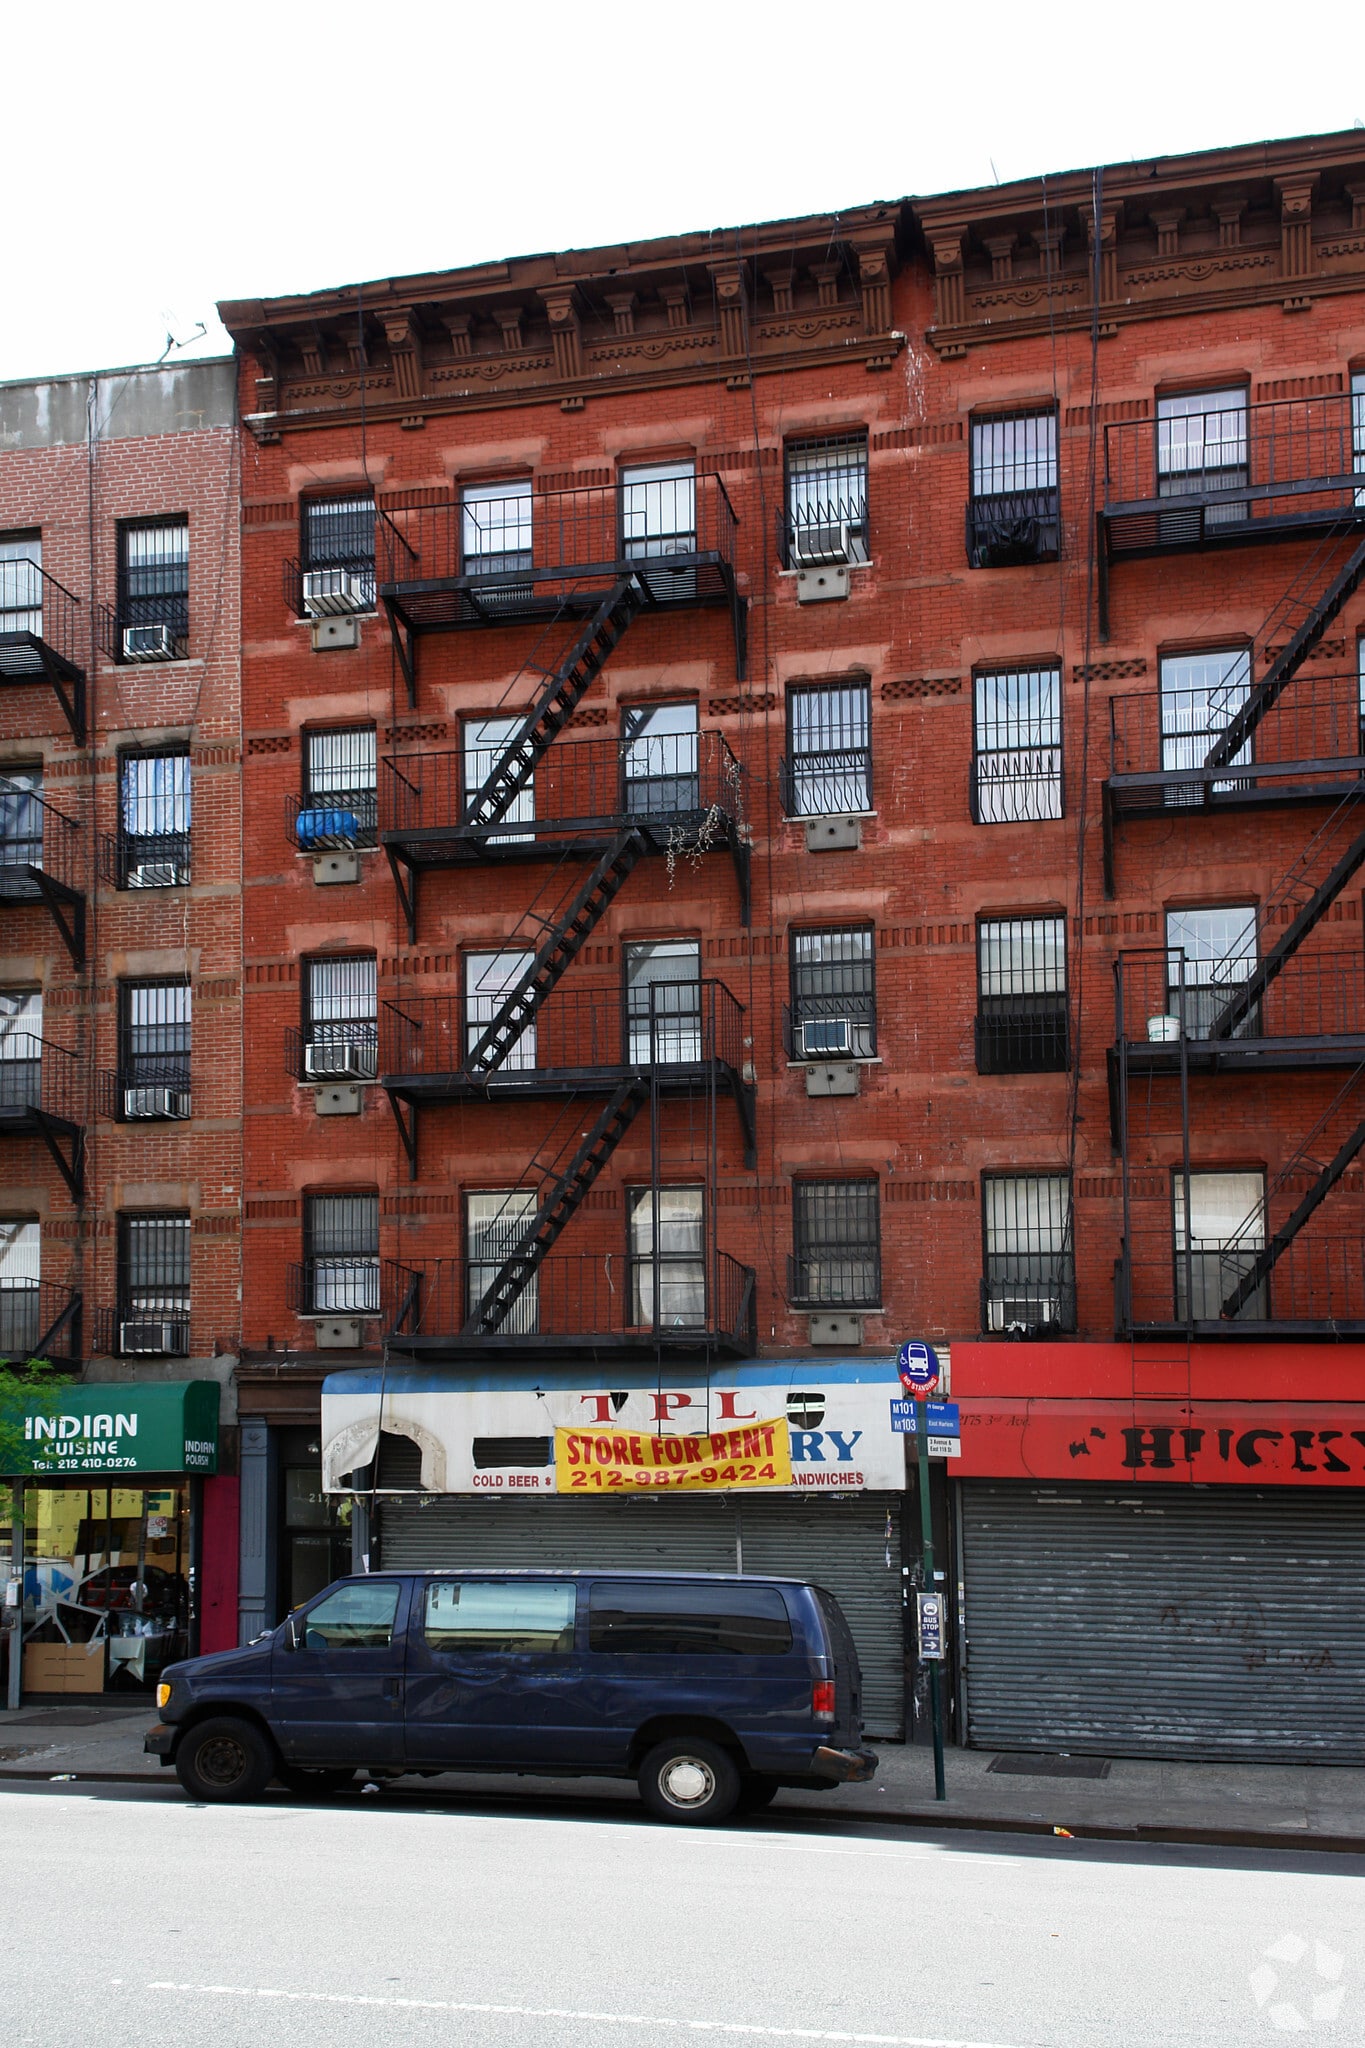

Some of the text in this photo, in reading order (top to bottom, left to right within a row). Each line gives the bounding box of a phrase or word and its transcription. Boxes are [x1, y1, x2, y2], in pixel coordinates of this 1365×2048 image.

[903, 1376, 937, 1391] NO STANDING
[892, 1402, 914, 1415] M101
[24, 1413, 138, 1440] INDIAN
[894, 1419, 916, 1431] M103
[43, 1441, 118, 1456] CUISINE
[184, 1440, 215, 1454] INDIAN
[567, 1426, 775, 1466] STORE FOR RENT
[789, 1430, 863, 1462] RY
[32, 1457, 137, 1470] Tel: 212 410-0276
[472, 1475, 504, 1487] COLD
[508, 1474, 539, 1487] BEER
[571, 1462, 777, 1487] 212-987-9424
[791, 1472, 864, 1486] ANDWICHES
